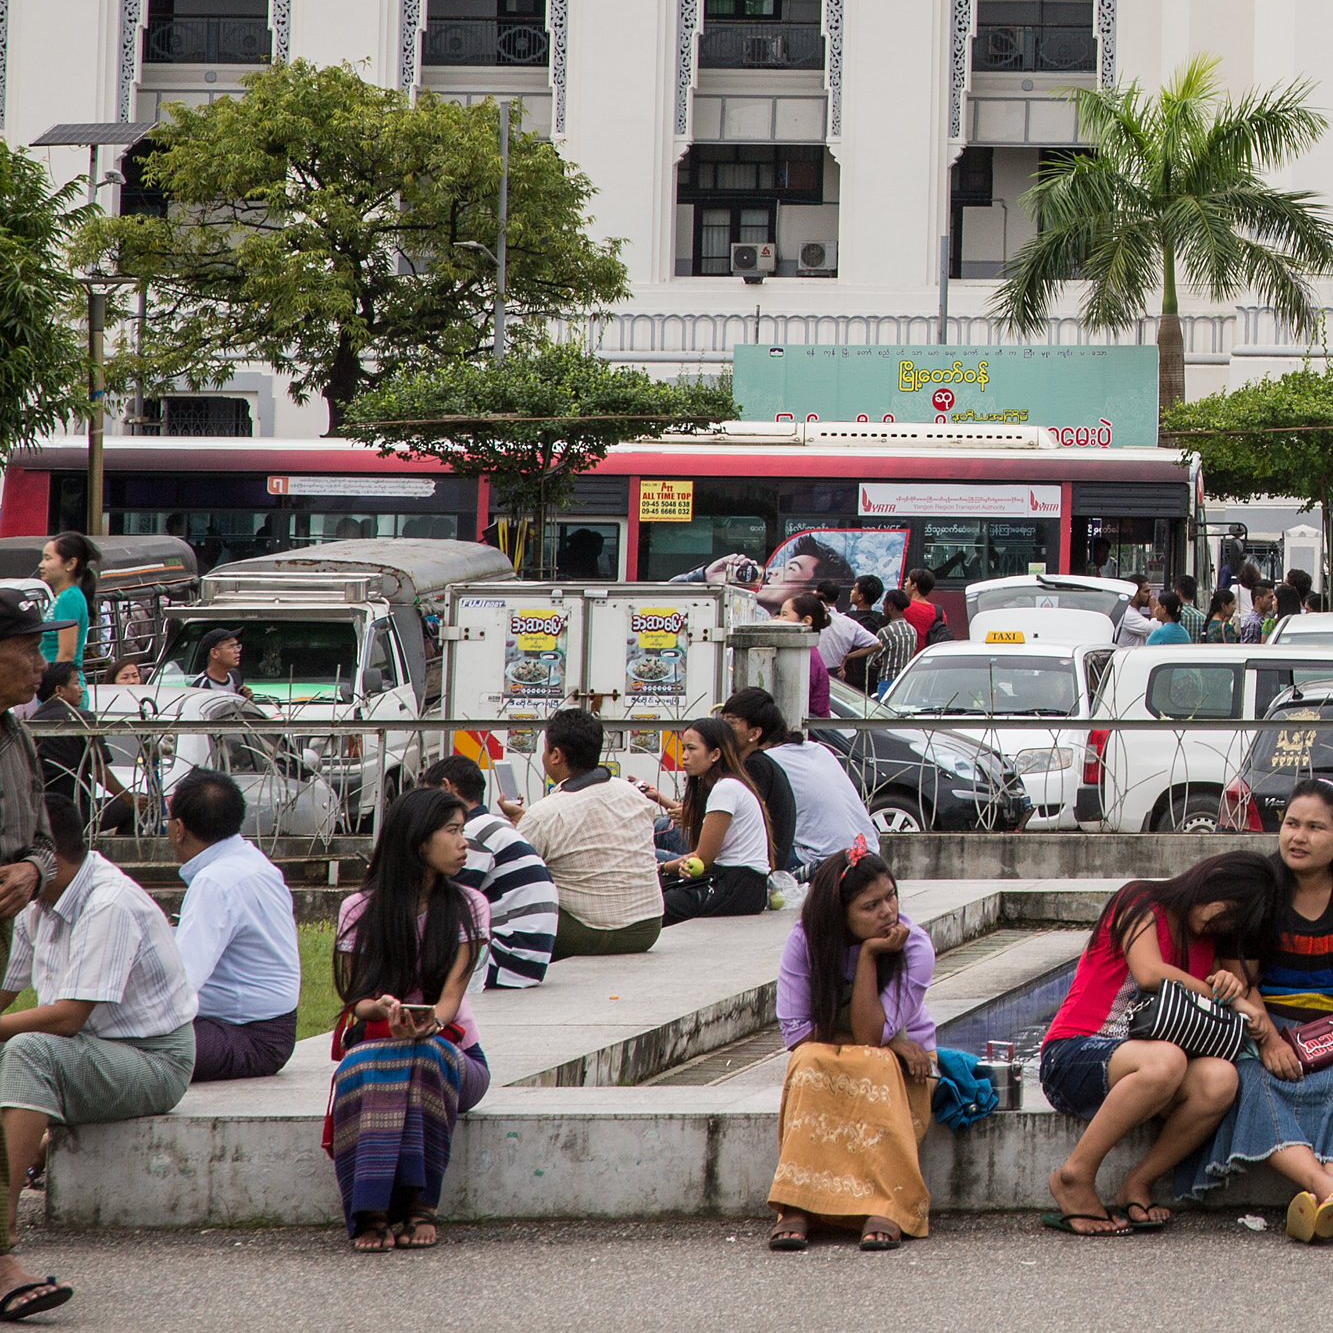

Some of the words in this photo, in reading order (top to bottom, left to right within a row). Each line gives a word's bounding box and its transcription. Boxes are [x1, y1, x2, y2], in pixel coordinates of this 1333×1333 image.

[898, 360, 990, 392] မြို့တော်ဝန်
[642, 492, 655, 500] ALL
[656, 492, 675, 500] TIME
[676, 492, 692, 500] TOP
[461, 600, 486, 608] FUJI
[992, 632, 1017, 640] TAXI
